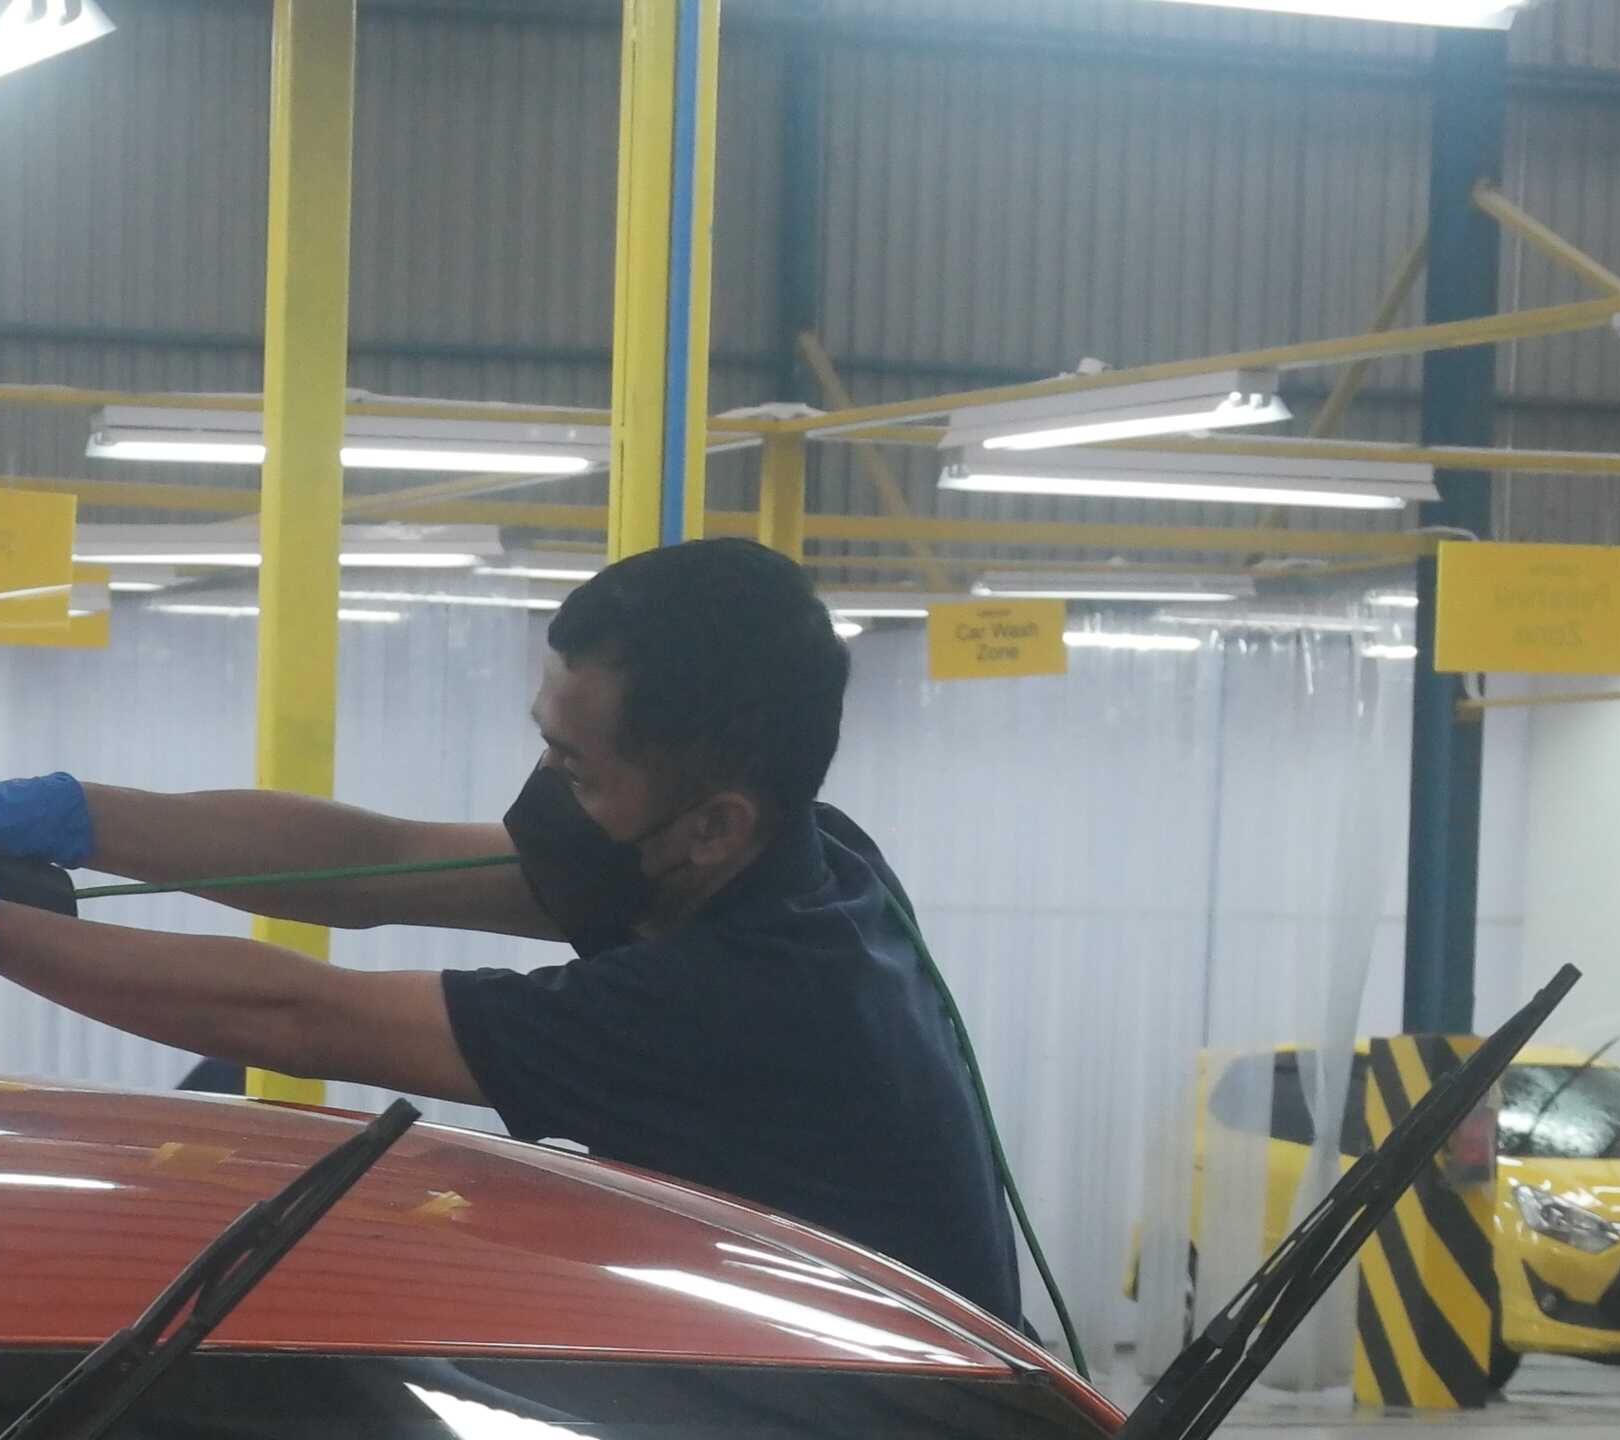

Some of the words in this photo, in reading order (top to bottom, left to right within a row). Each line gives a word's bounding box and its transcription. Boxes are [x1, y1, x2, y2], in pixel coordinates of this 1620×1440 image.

[956, 623, 985, 641] Car
[991, 621, 1039, 639] Wash
[977, 643, 1020, 661] Zone
